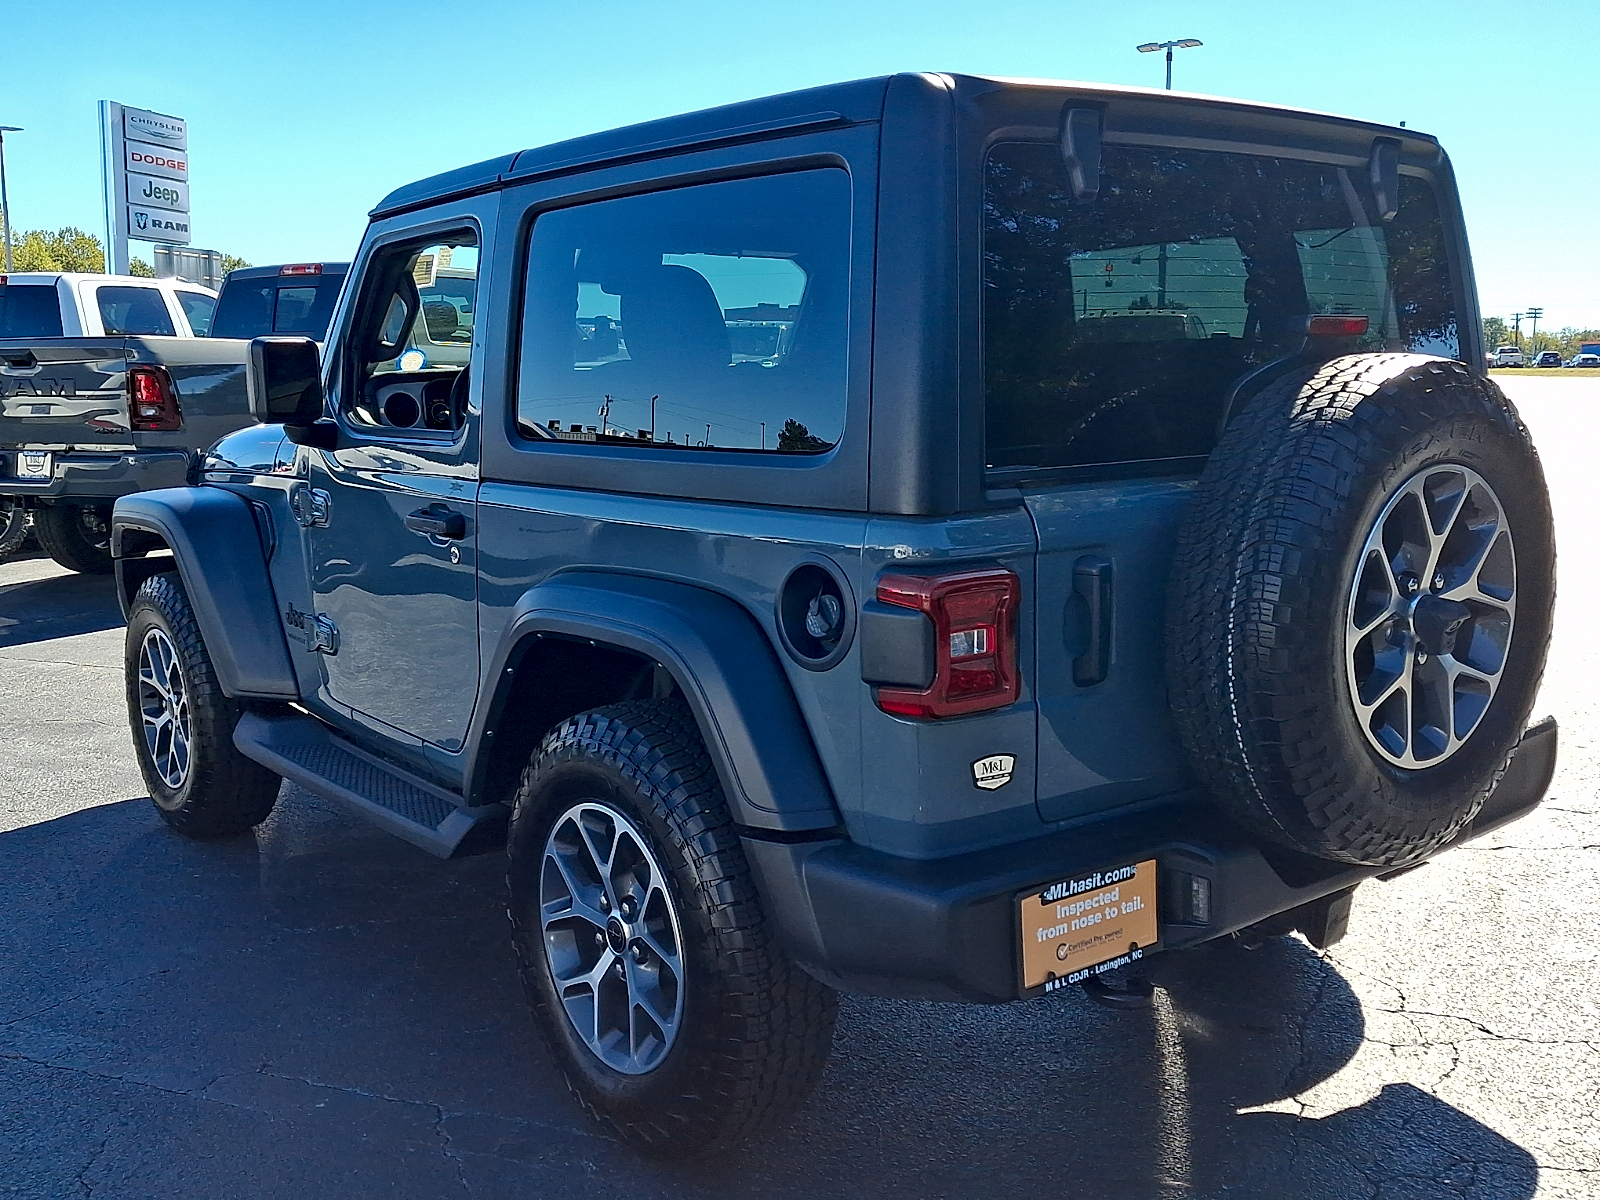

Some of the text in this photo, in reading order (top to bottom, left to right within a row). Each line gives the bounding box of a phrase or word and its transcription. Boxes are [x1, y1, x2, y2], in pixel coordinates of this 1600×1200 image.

[130, 116, 183, 133] CHRYSLER
[131, 152, 186, 171] DODGE
[142, 181, 179, 204] Jeep
[151, 219, 188, 232] RAM
[0, 378, 76, 396] AM
[286, 602, 304, 629] Jee
[982, 759, 1006, 775] M&L
[1049, 866, 1131, 900] MLhasit.com
[1057, 887, 1120, 919] Inspected
[1036, 896, 1145, 942] from nose to tail.
[1045, 982, 1053, 992] M
[1054, 980, 1060, 989] &
[1062, 977, 1067, 986] L
[1068, 969, 1089, 984] CDJR
[1132, 949, 1143, 960] NC
